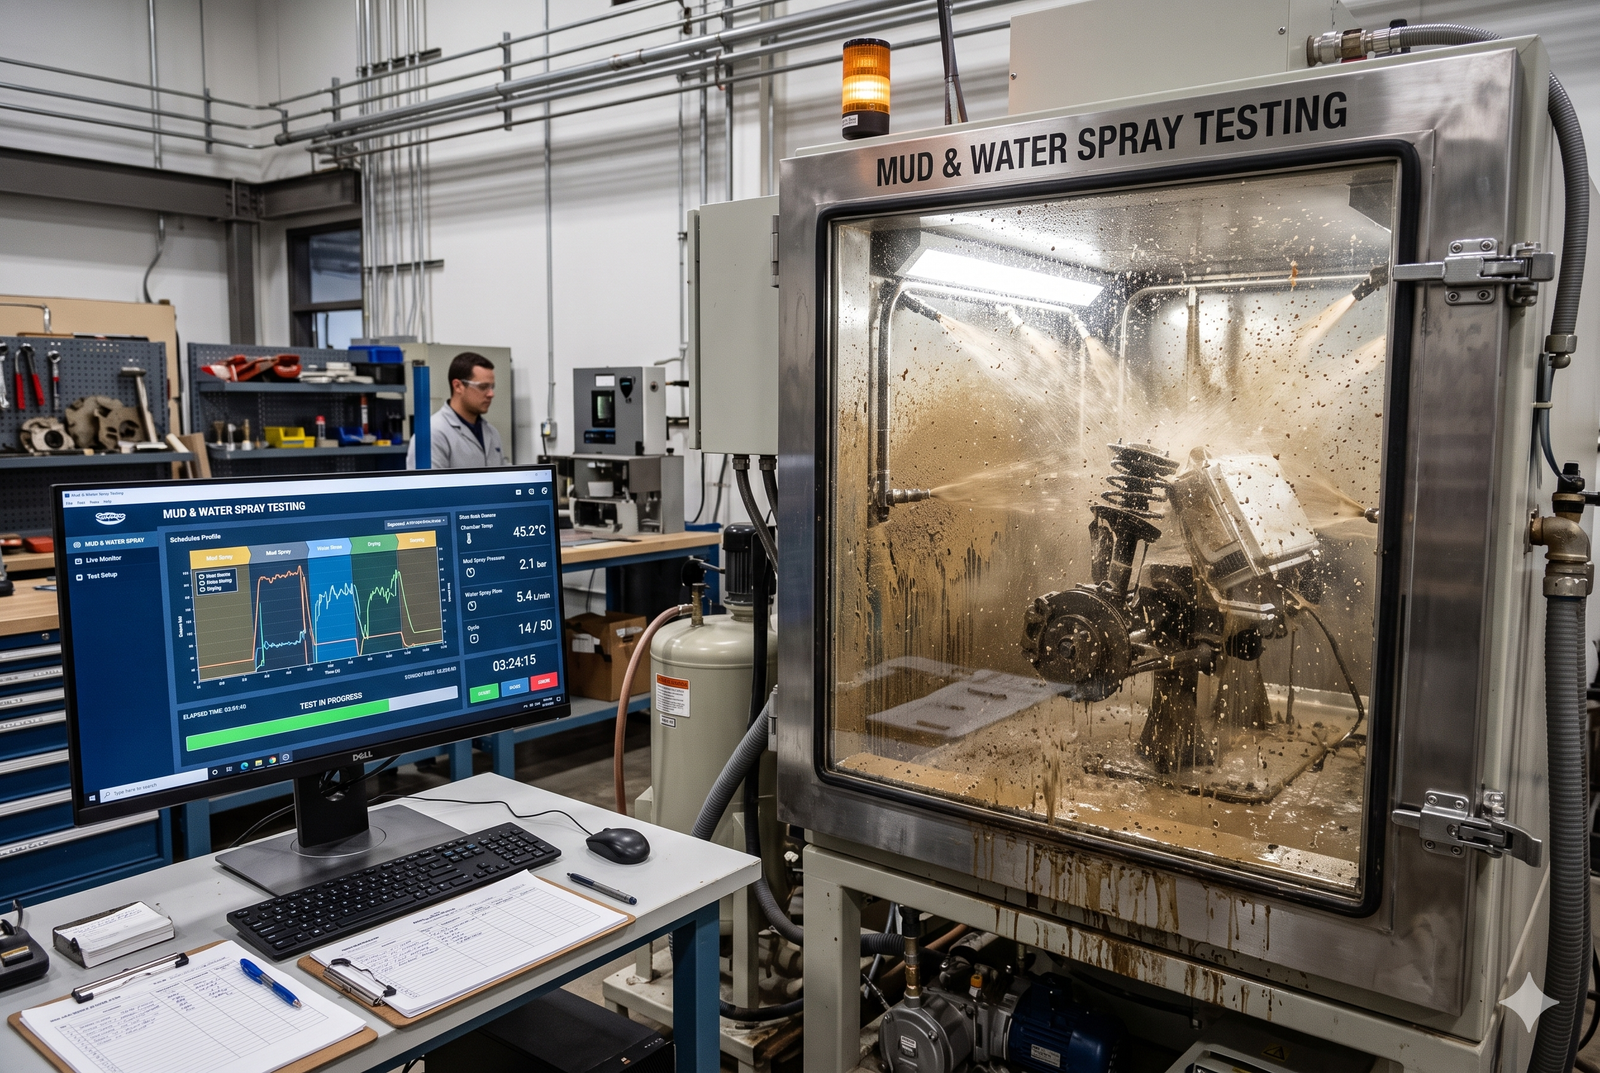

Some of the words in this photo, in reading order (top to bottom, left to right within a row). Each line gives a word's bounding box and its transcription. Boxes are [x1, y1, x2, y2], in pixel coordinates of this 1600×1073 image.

[877, 151, 934, 187] MUD
[942, 147, 962, 178] &
[970, 132, 1067, 175] WATER
[1077, 114, 1184, 161] SPRAY
[1194, 91, 1348, 146] TESTING
[163, 508, 188, 519] MUD
[189, 507, 196, 517] &
[198, 505, 233, 517] WATER
[234, 503, 266, 516] SPRAY
[267, 501, 306, 513] TESTING
[513, 524, 546, 537] 45.2°C
[519, 558, 534, 570] 2.1
[101, 571, 118, 580] Setup
[517, 590, 532, 602] 5.4
[519, 622, 531, 634] 14
[532, 621, 538, 633] /
[540, 619, 552, 631] 50
[492, 654, 536, 672] 03:24:15
[300, 700, 317, 710] TEST
[318, 698, 326, 706] IN
[327, 692, 362, 705] PROGRESS
[183, 710, 208, 720] ELAPSED
[352, 751, 373, 762] DELL
